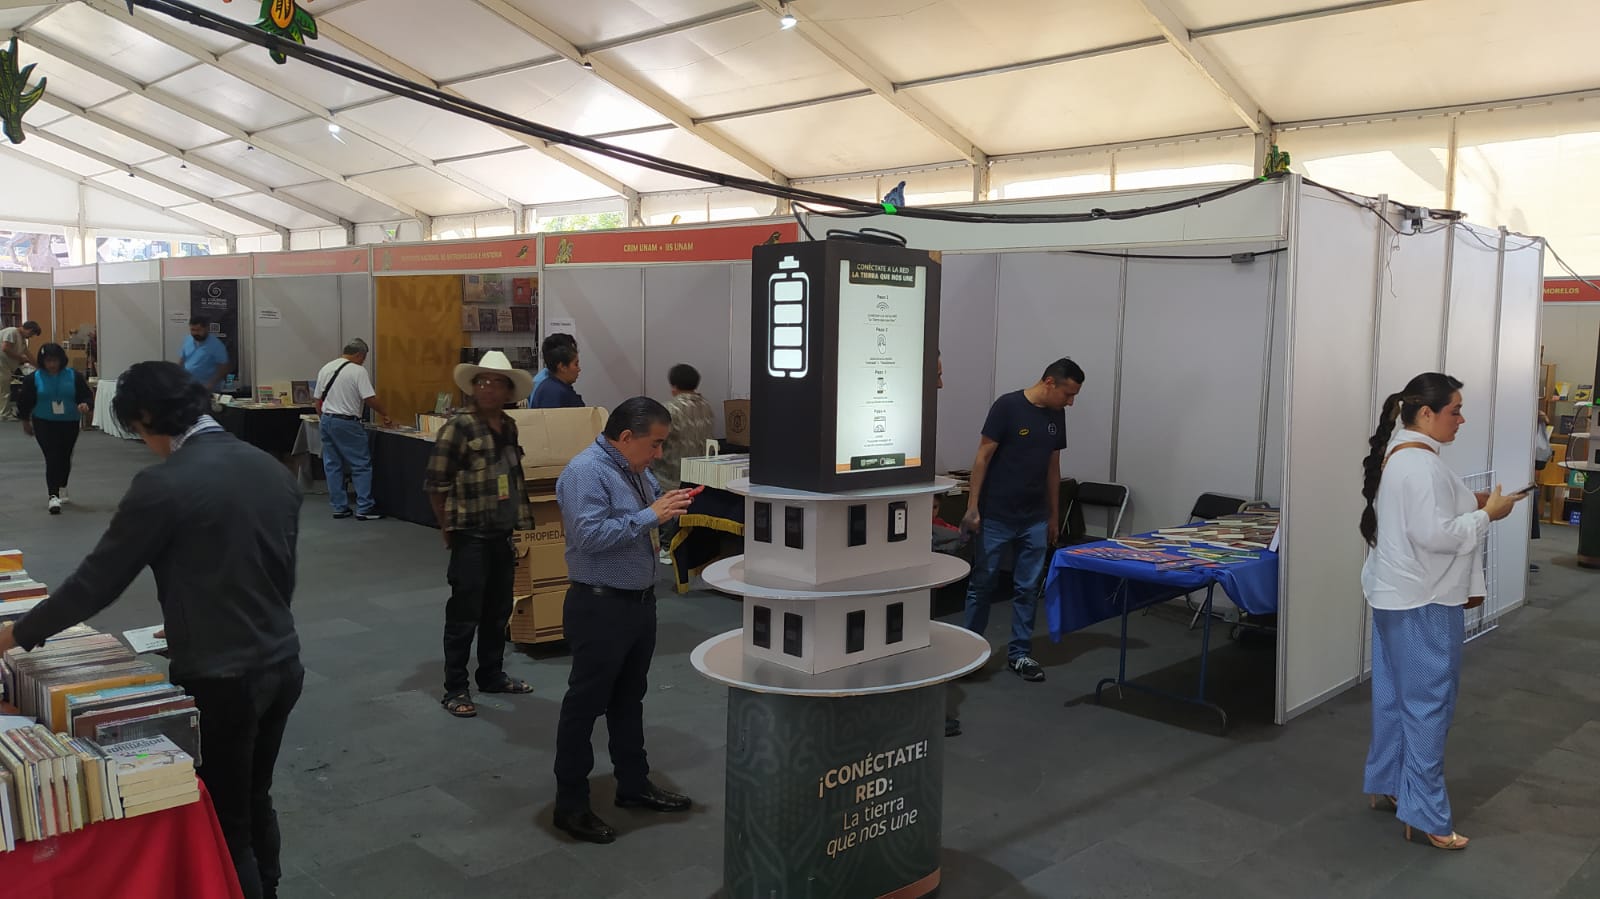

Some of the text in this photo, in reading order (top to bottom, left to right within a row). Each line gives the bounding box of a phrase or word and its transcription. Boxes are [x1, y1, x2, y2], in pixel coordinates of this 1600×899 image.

[640, 243, 657, 252] UNAM
[675, 241, 694, 251] UNAM
[857, 262, 886, 272] CONÉCTATE
[860, 271, 878, 280] TIERRA
[818, 740, 928, 798] ¡CONÉCTATE!
[855, 777, 893, 804] RED:
[843, 796, 904, 831] La tierra
[826, 808, 918, 859] que nos une
